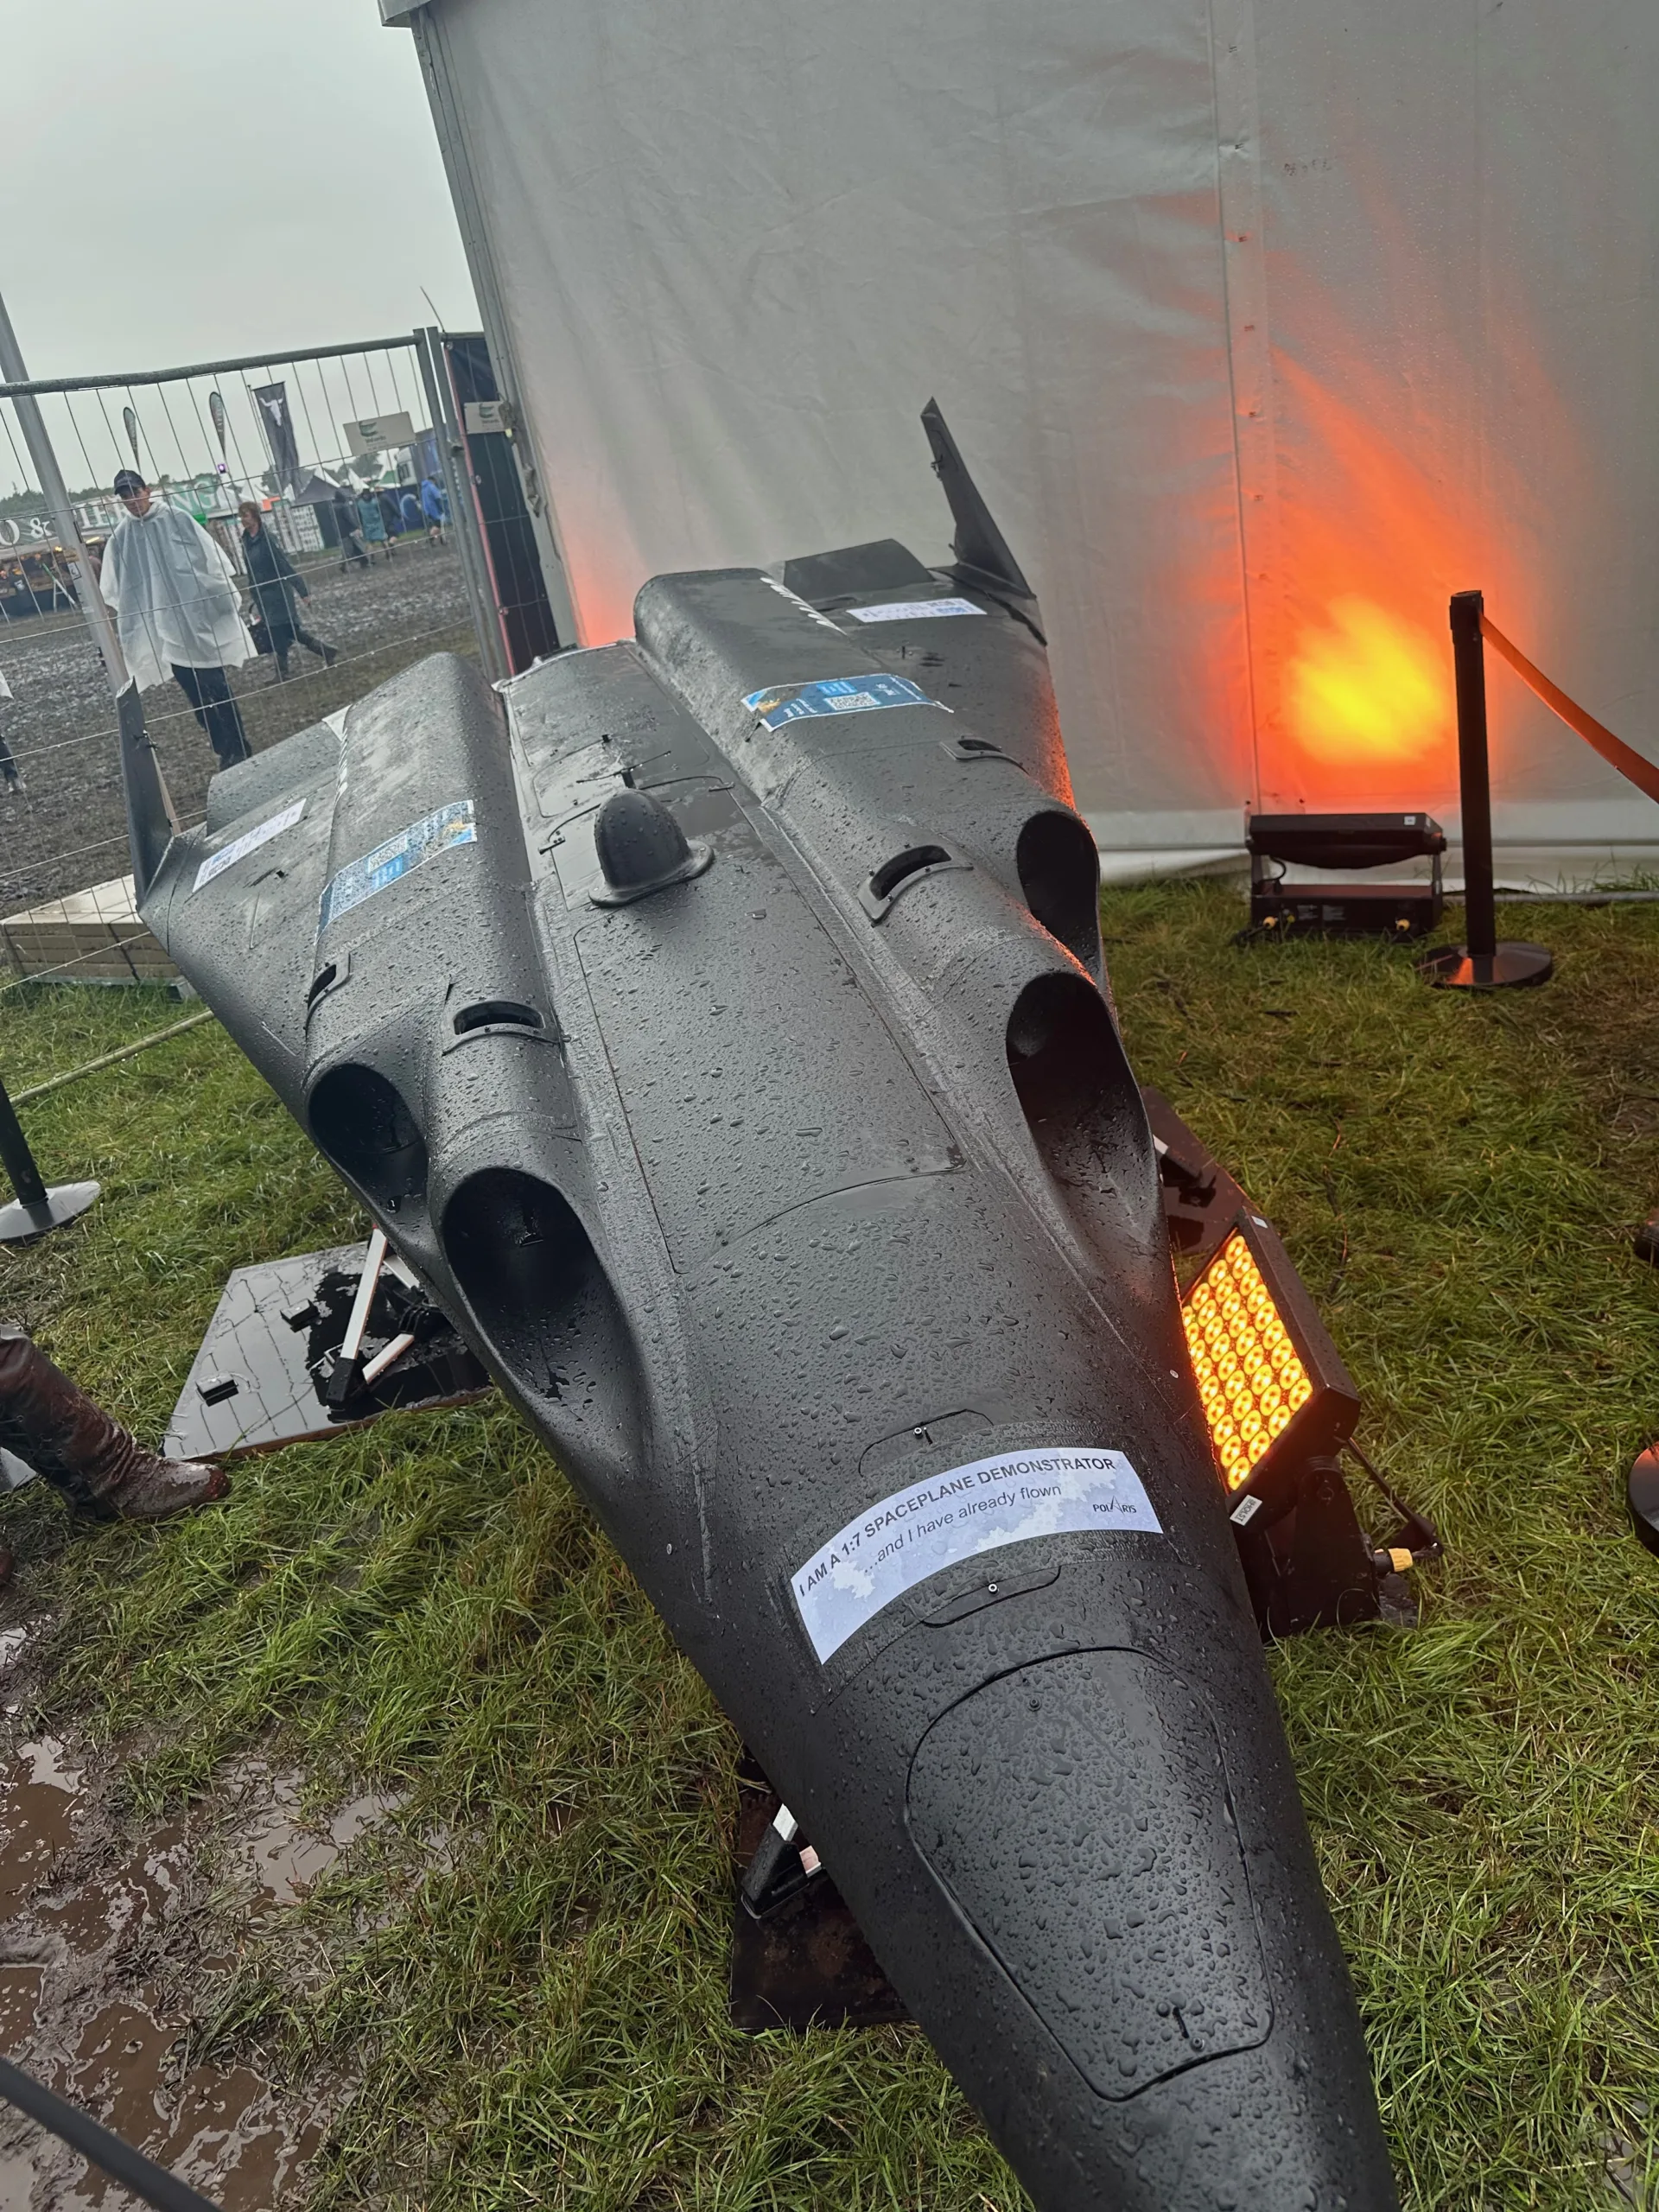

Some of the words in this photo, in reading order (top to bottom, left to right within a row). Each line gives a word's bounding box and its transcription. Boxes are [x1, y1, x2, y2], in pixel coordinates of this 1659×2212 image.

[30, 518, 52, 539] &
[799, 1584, 805, 1597] I
[808, 1562, 828, 1591] AM
[830, 1554, 841, 1568] A
[842, 1532, 861, 1555] 1:7
[864, 1476, 976, 1538] SPACEPLANE
[976, 1458, 1116, 1484] DEMONSTRATOR
[865, 1534, 904, 1573] ...and
[908, 1529, 913, 1542] I
[917, 1513, 954, 1538] have
[959, 1491, 1015, 1518] already
[1020, 1485, 1062, 1500] flown
[1093, 1496, 1137, 1516] POLARIS
